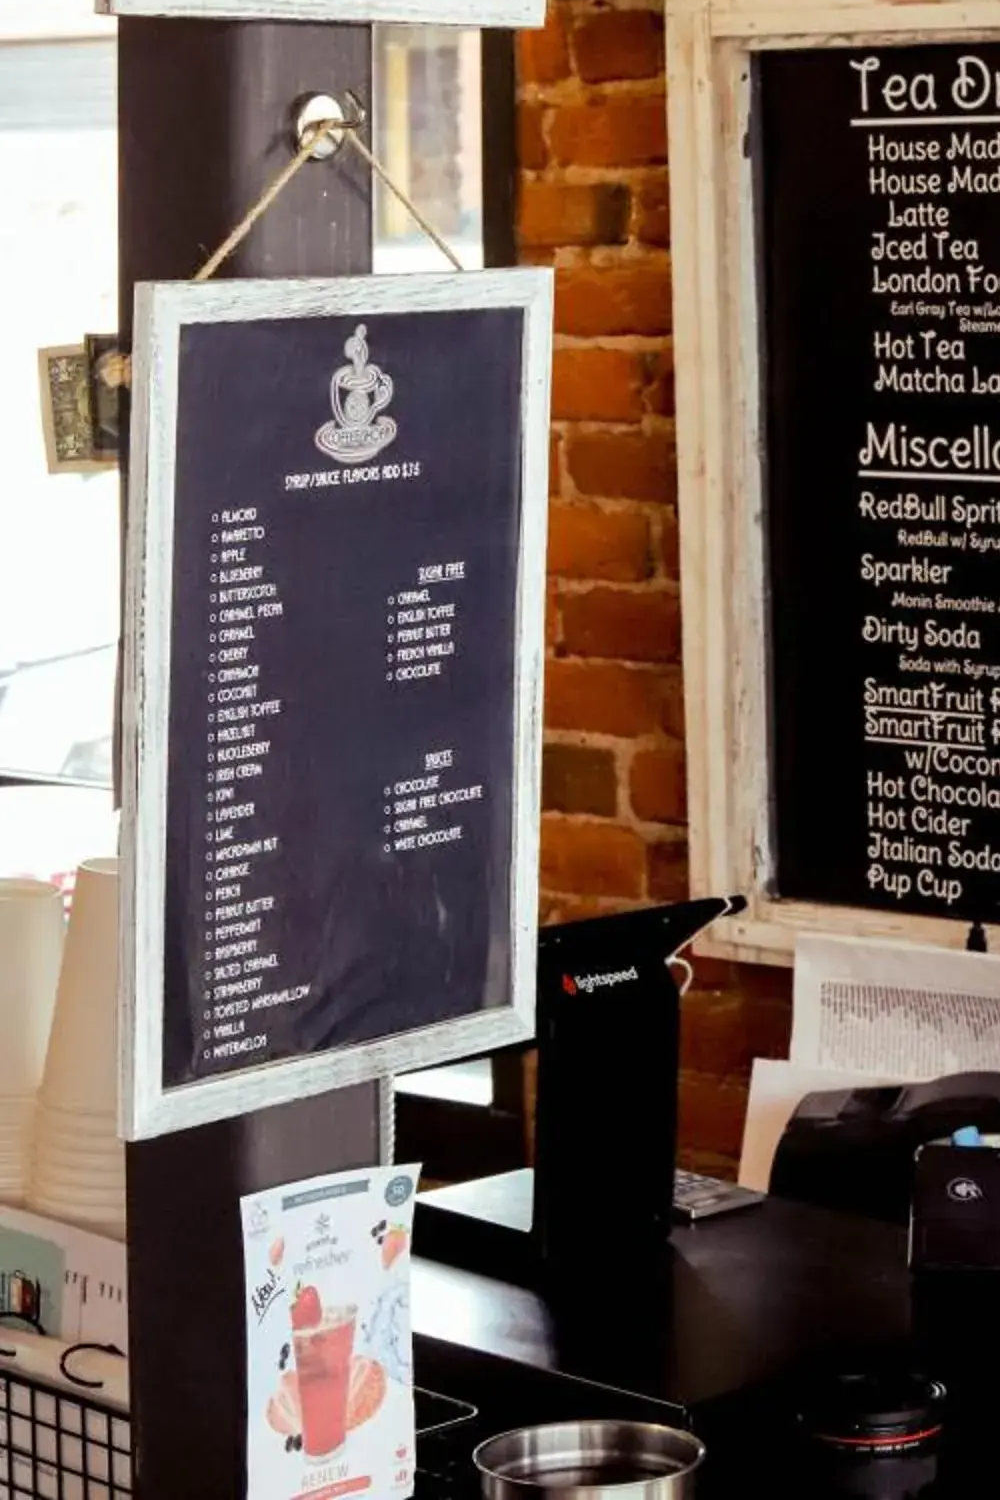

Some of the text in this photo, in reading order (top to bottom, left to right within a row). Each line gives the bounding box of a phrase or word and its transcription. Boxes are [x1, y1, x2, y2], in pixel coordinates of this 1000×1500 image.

[849, 56, 938, 112] Tea
[867, 134, 941, 162] House
[871, 265, 961, 294] London
[873, 329, 966, 360] Hot Tea
[873, 364, 966, 394] Matcha
[858, 491, 946, 521] RedBull
[860, 553, 953, 587] Sparkler
[861, 615, 981, 652] Dirty Soda
[863, 676, 985, 713] SmartFruit
[866, 771, 906, 800] Hot
[866, 863, 963, 905] Pup Cup
